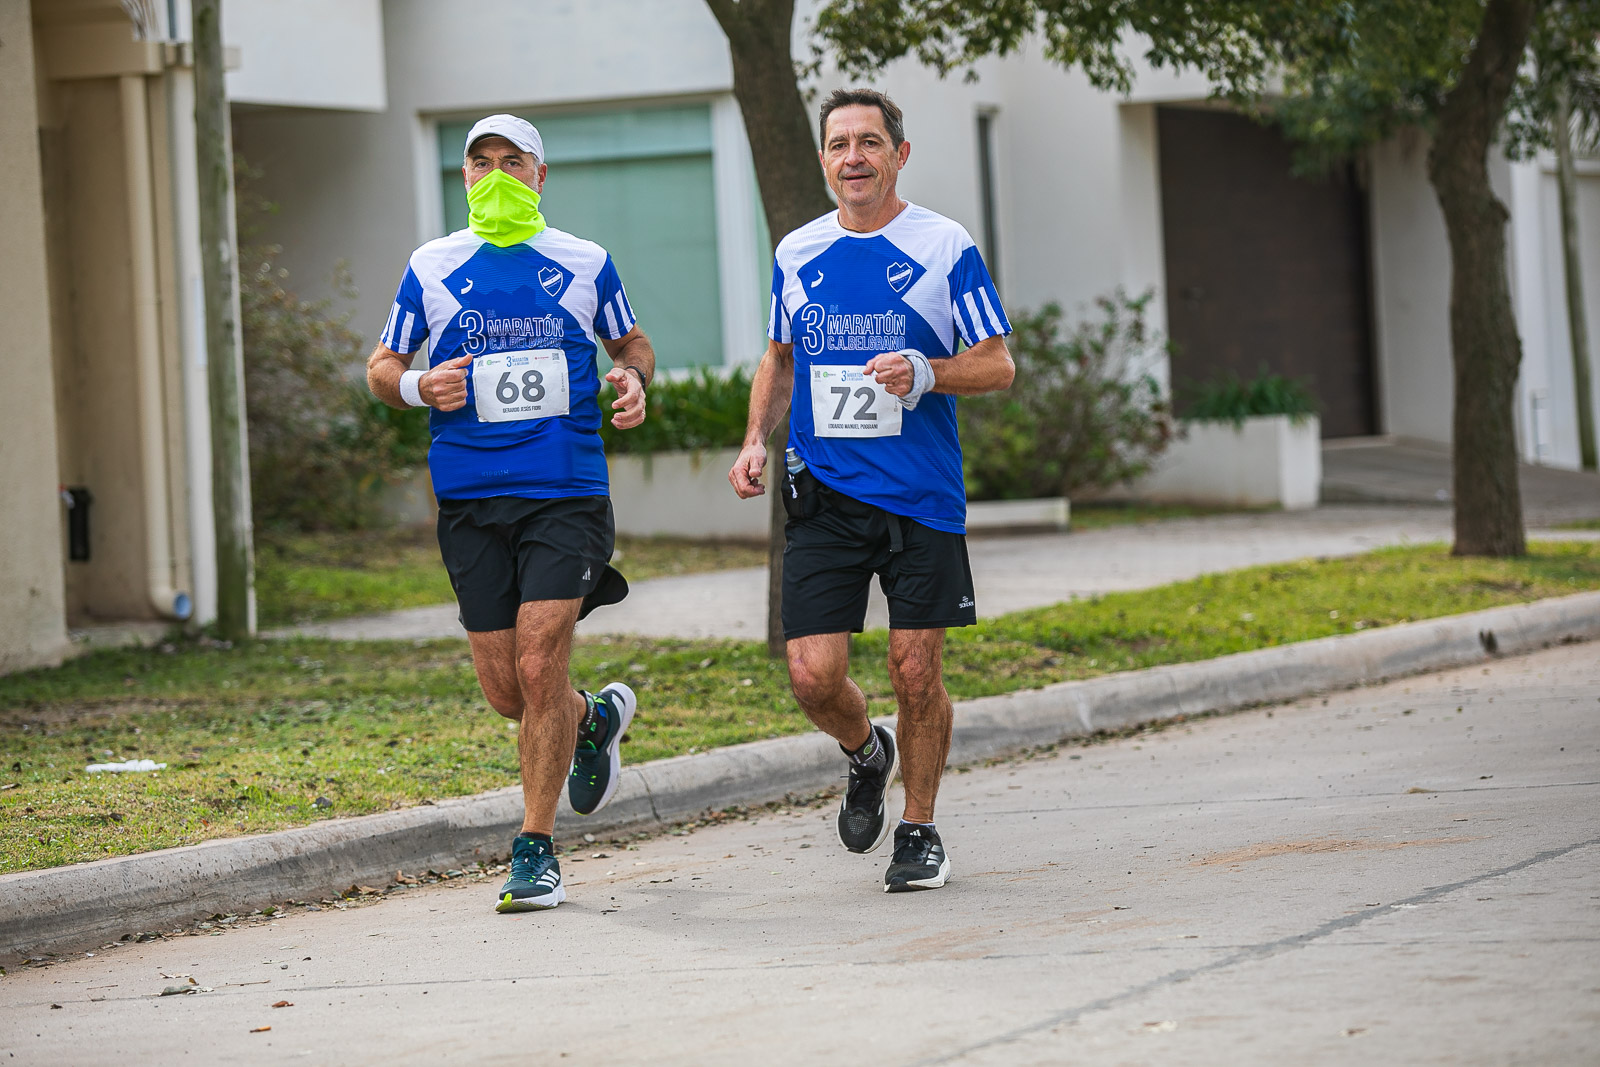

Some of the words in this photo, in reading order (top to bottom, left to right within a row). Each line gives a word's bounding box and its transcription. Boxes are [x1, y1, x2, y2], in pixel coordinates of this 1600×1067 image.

[459, 310, 487, 356] 3
[486, 313, 564, 338] MARATÓN
[801, 303, 826, 355] 3
[827, 309, 906, 335] MARATÓN
[506, 356, 512, 368] 3
[841, 370, 847, 381] 3
[495, 369, 546, 405] 68
[830, 386, 877, 421] 72
